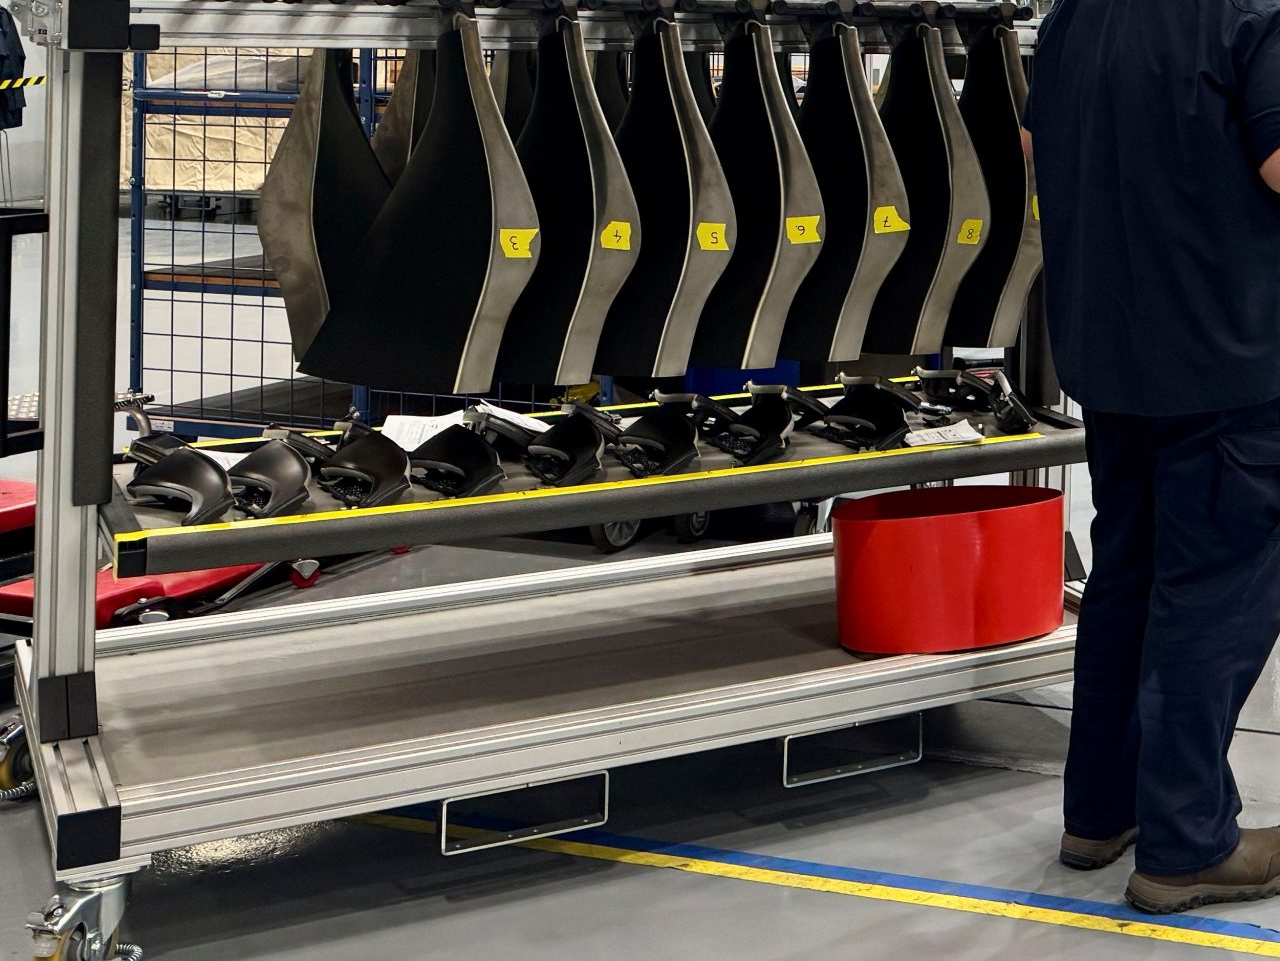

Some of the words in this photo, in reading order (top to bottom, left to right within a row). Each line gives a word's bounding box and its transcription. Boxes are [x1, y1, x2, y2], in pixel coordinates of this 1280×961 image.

[613, 229, 622, 243] 4
[710, 231, 719, 244] 5
[966, 228, 975, 239] 8
[509, 235, 519, 250] 3
